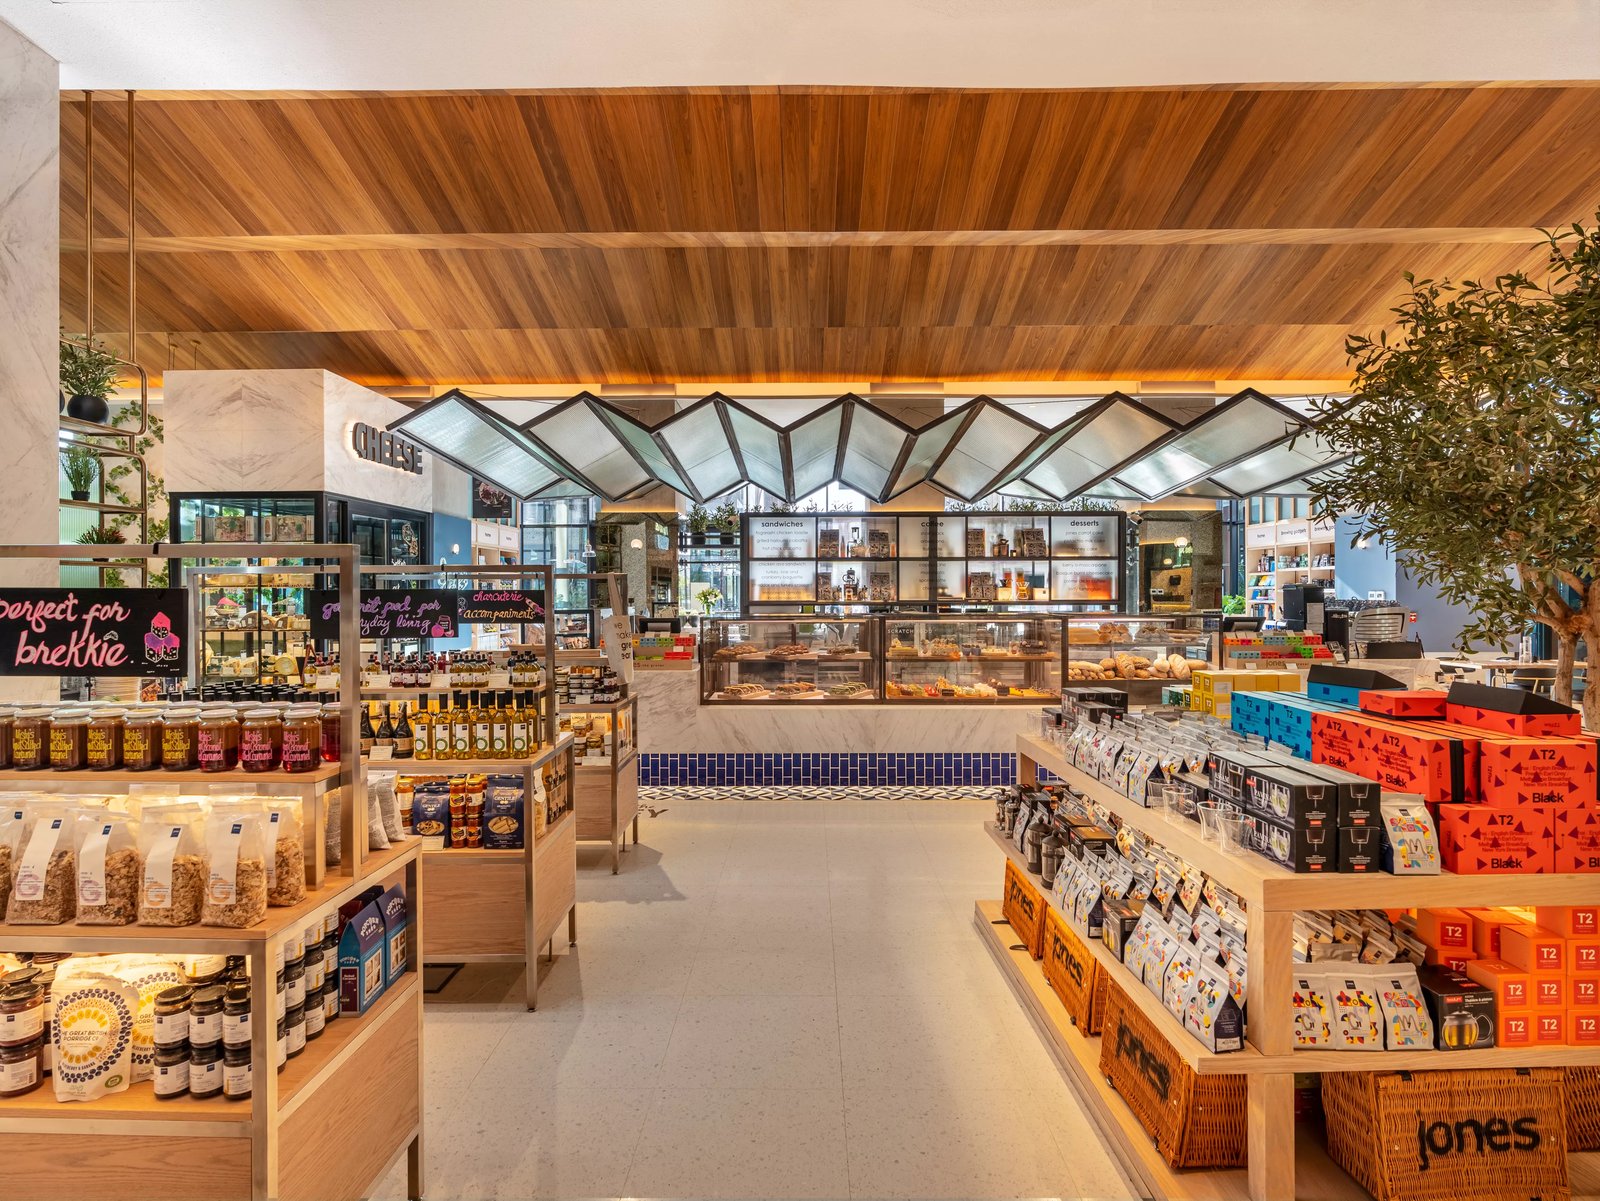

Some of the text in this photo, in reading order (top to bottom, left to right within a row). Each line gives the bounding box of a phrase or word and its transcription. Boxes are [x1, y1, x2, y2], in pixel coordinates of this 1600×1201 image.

[352, 421, 423, 475] CHEESE
[322, 596, 381, 620] gomet
[464, 608, 536, 622] accompaniments
[81, 601, 131, 644] for
[360, 614, 390, 636] ryday
[1286, 710, 1293, 718] T2
[1332, 721, 1341, 731] T2
[1390, 736, 1400, 747] T2
[1540, 750, 1555, 760] T2
[1329, 756, 1347, 768] Black
[1386, 774, 1407, 788] Black
[1532, 792, 1564, 803] Black
[1499, 815, 1513, 825] T2
[1491, 858, 1522, 868] Black
[1010, 877, 1034, 922] jones
[386, 898, 404, 915] POPCORN
[1577, 913, 1593, 924] T2
[360, 917, 379, 936] POPCORN
[1446, 926, 1462, 937] T2
[1052, 929, 1084, 988] jones
[1541, 948, 1557, 959] T2
[1580, 950, 1596, 960] T2
[1450, 960, 1466, 971] T2
[1508, 985, 1522, 995] T2
[1542, 984, 1557, 995] T2
[1578, 984, 1594, 994] T2
[1509, 1021, 1525, 1032] T2
[1542, 1019, 1557, 1030] T2
[1580, 1020, 1595, 1030] T2
[1115, 1008, 1171, 1102] jones
[1415, 1109, 1541, 1171] jones
